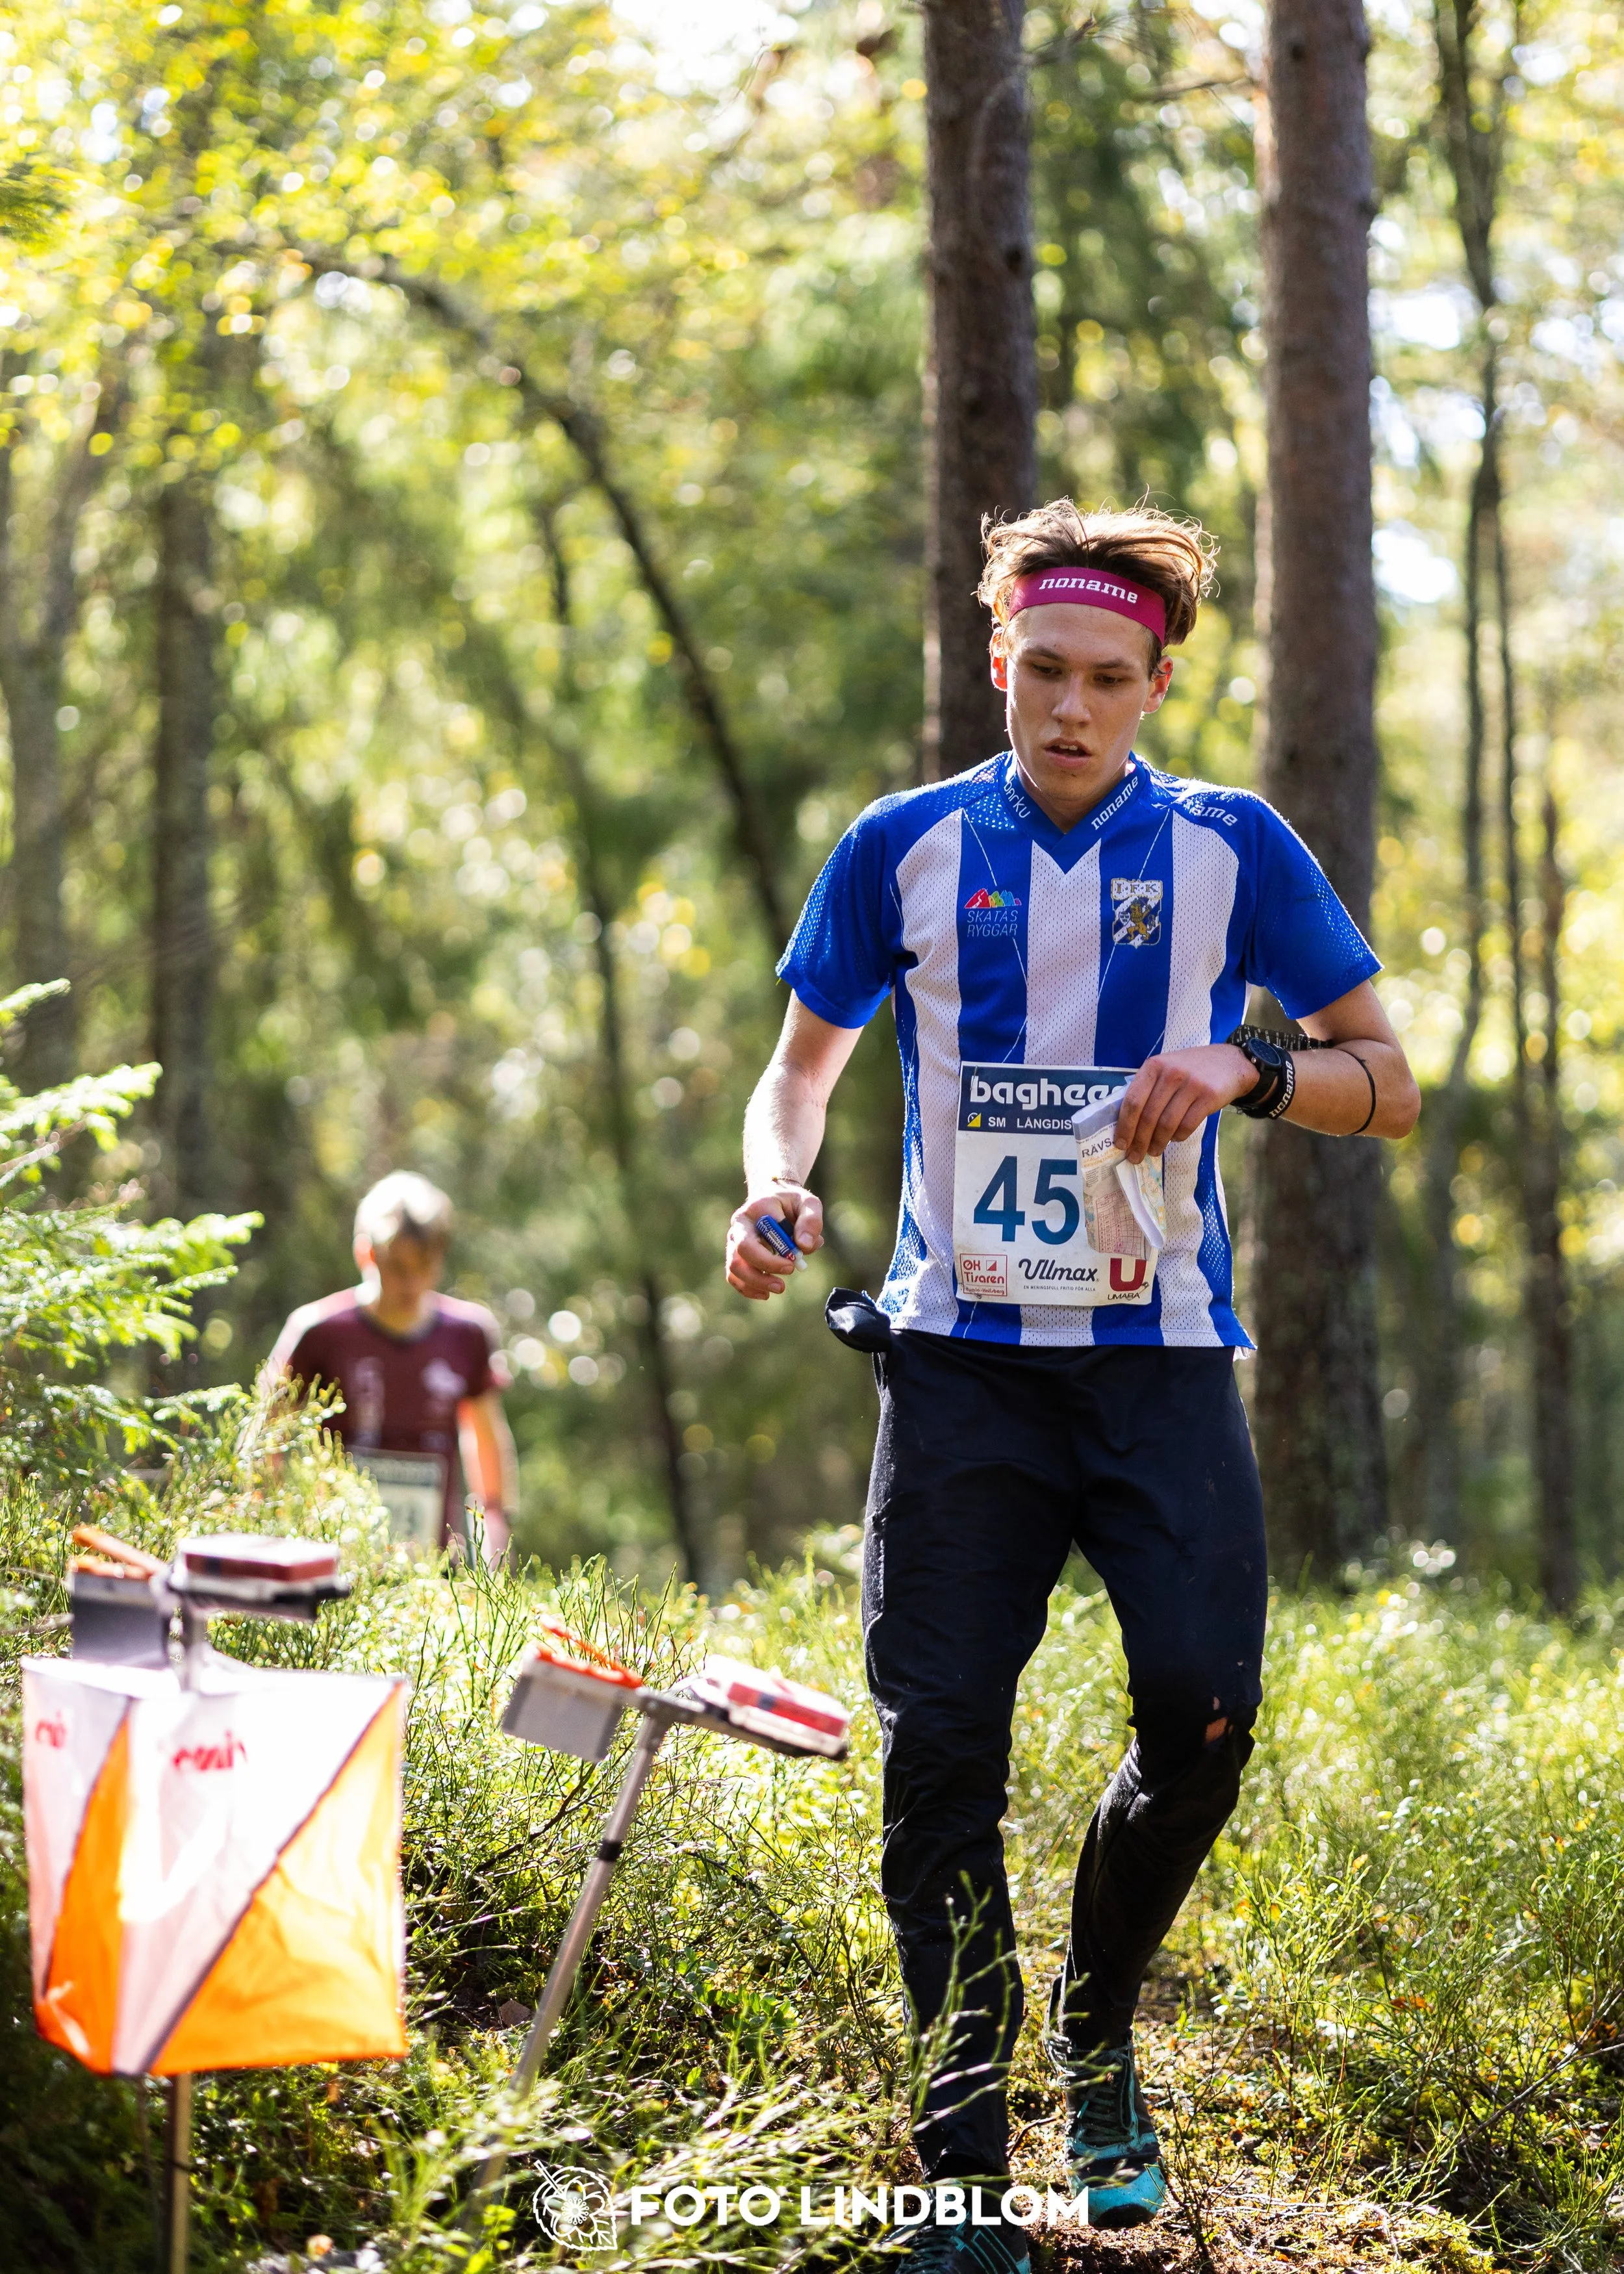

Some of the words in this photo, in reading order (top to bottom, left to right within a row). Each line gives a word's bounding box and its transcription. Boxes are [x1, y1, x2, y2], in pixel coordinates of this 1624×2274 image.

[1039, 578, 1138, 604] noname
[1091, 776, 1138, 830] noname
[967, 923, 1018, 937] RYGGAR
[1269, 1060, 1294, 1118] noname
[988, 1117, 1006, 1127] SM
[1082, 1138, 1115, 1158] RÄVS
[973, 1155, 1080, 1246] 45
[964, 1271, 1004, 1284] Tisaren
[1018, 1258, 1098, 1282] Ullmax
